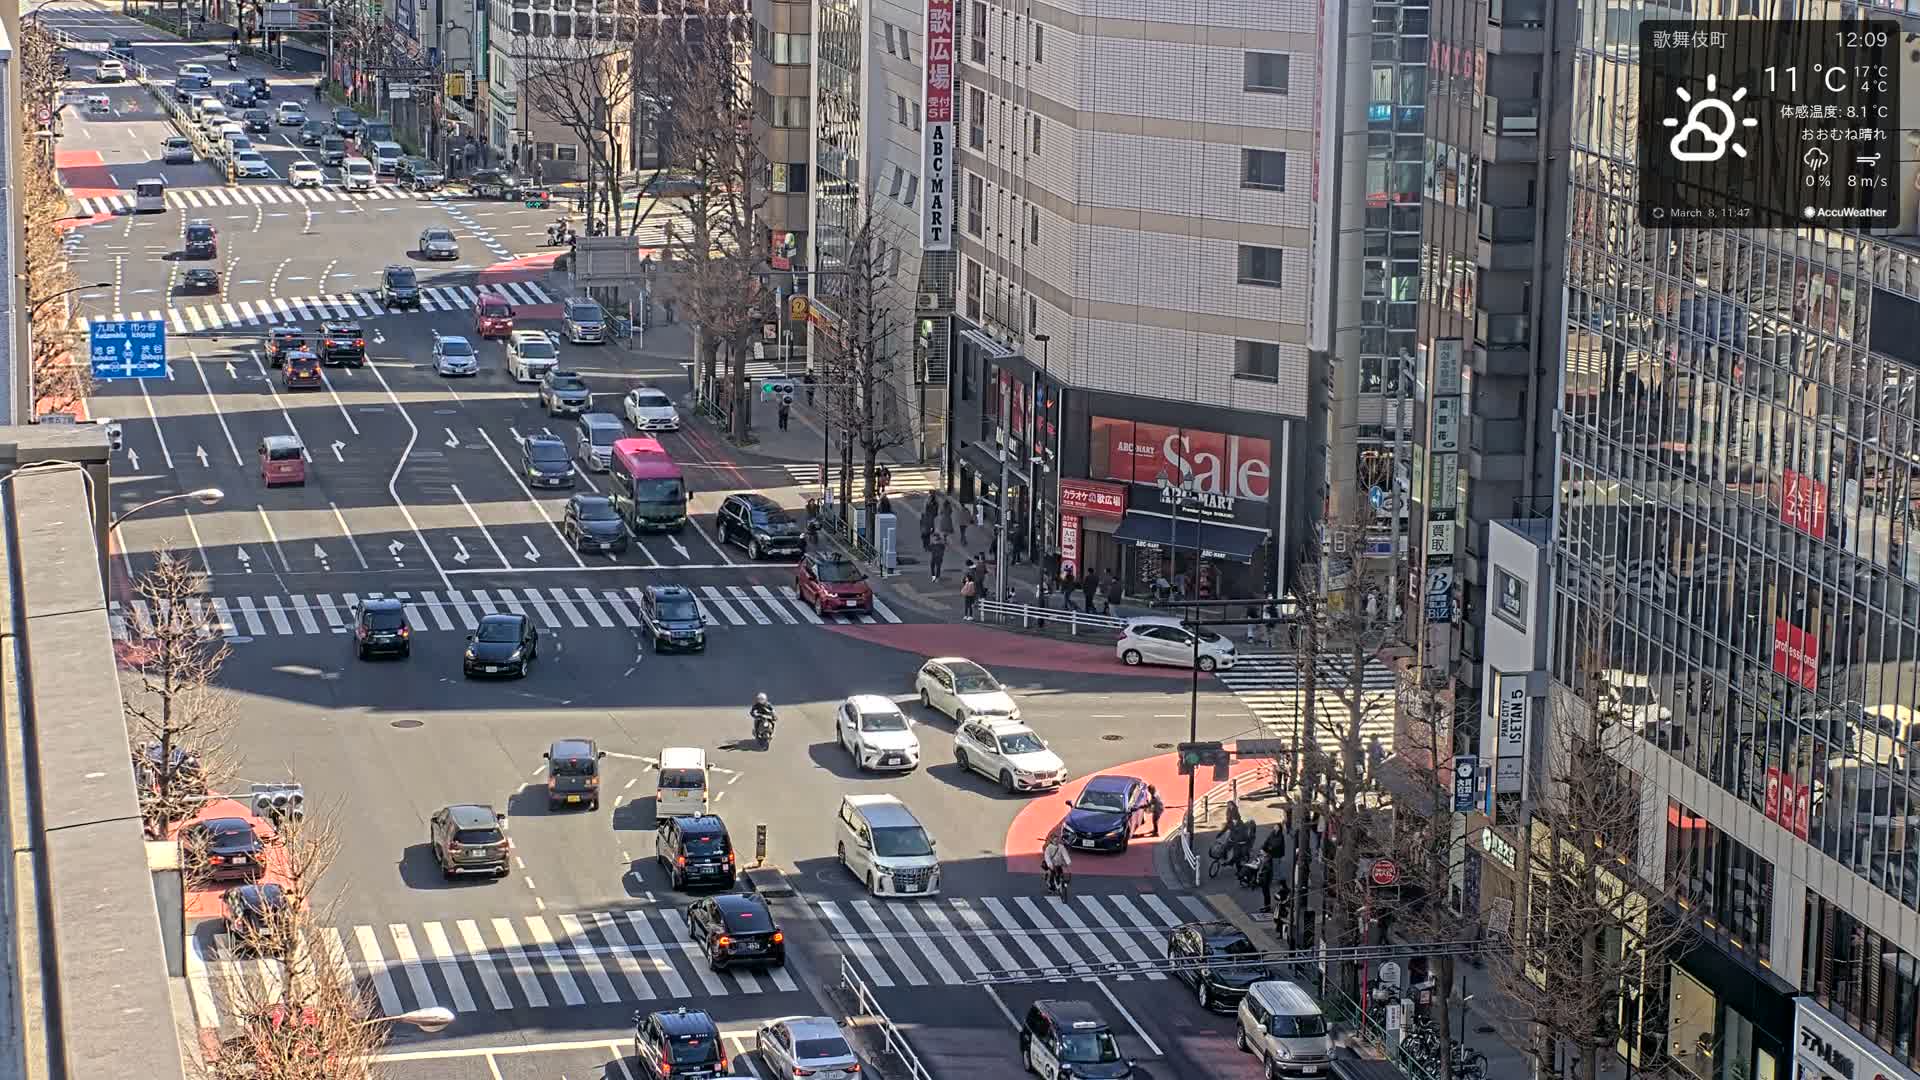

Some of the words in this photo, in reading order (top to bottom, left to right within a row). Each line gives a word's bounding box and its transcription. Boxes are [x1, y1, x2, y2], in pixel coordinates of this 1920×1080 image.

[929, 9, 951, 89] 歌広場
[928, 97, 950, 107] 受付
[928, 109, 949, 118] 5F
[97, 323, 125, 332] 九段下
[1163, 434, 1270, 499] Sale
[1063, 488, 1088, 501] カラオケ
[1096, 493, 1121, 507] 歌広場
[1431, 524, 1445, 552] 買取
[1775, 639, 1817, 669] professional
[1511, 689, 1523, 699] 5
[1501, 700, 1509, 718] CITY
[1501, 719, 1509, 737] PARK
[1509, 702, 1523, 744] ISETAN
